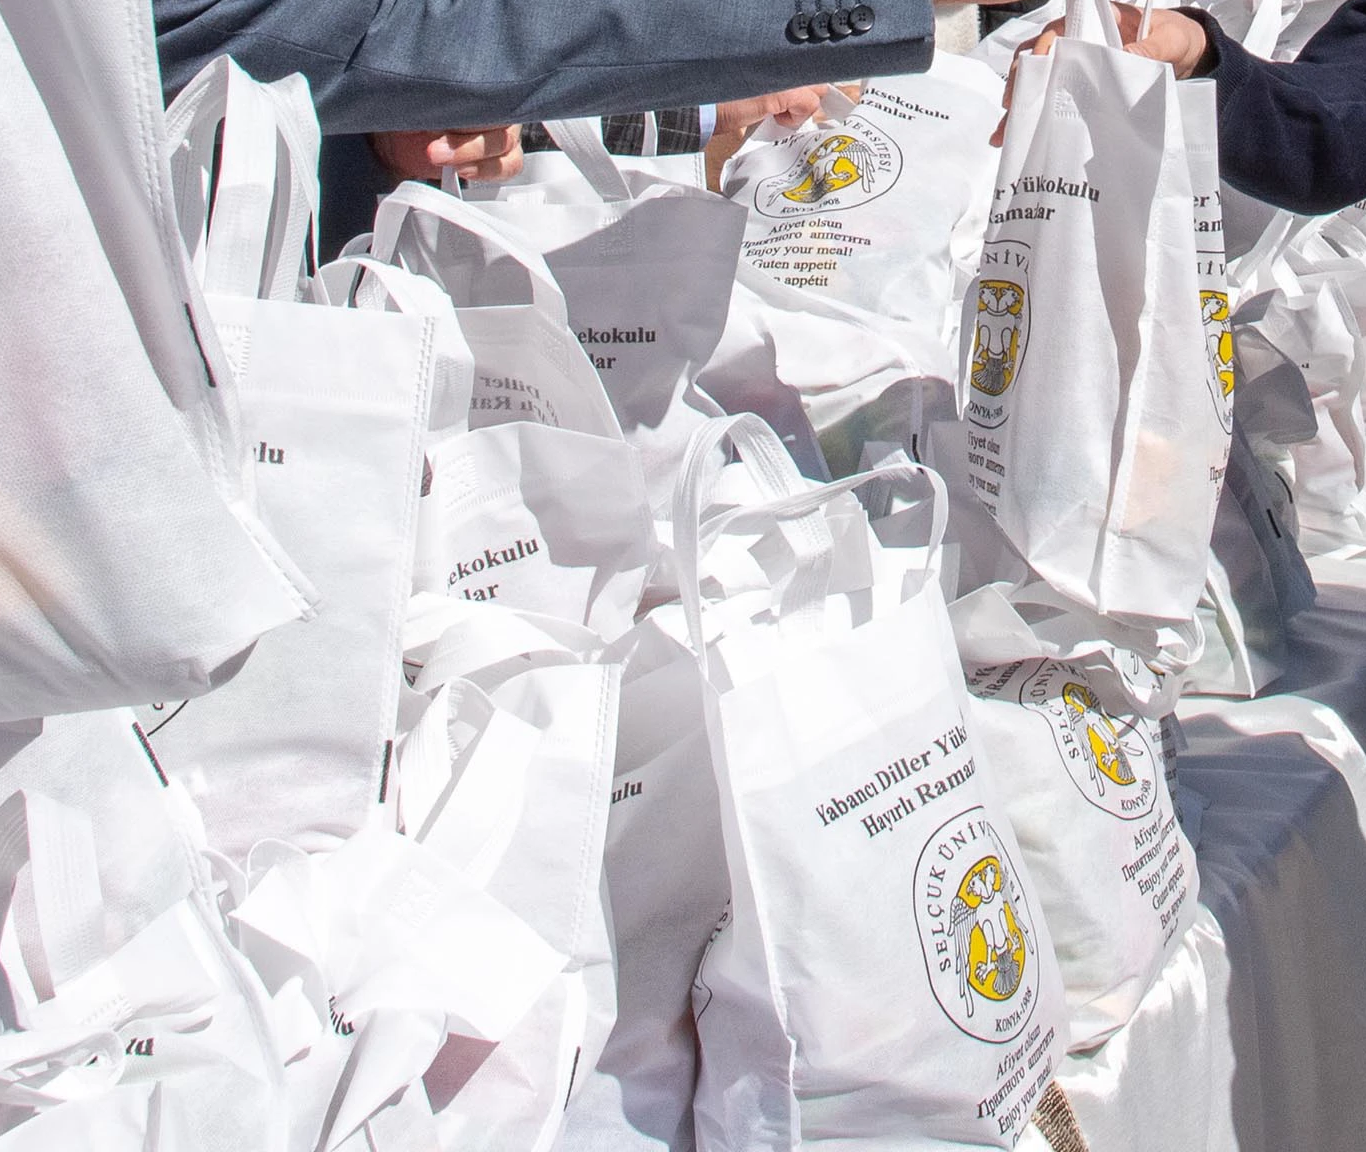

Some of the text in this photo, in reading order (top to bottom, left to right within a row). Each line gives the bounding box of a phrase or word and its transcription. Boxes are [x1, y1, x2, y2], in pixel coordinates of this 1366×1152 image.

[809, 218, 843, 230] olsun
[810, 230, 871, 246] аппетита
[745, 246, 853, 258] Enjoy your meal!
[793, 259, 837, 273] appetit
[784, 274, 829, 287] appétit
[816, 781, 879, 827] Yabancı
[874, 750, 931, 791] Diller
[860, 796, 917, 839] Hayırlı
[927, 865, 951, 972] SELÇUK
[996, 1044, 1024, 1081] Afiyet
[977, 1066, 1026, 1119] Приятного
[997, 1103, 1021, 1136] Enjoy
[1021, 1081, 1037, 1112] your
